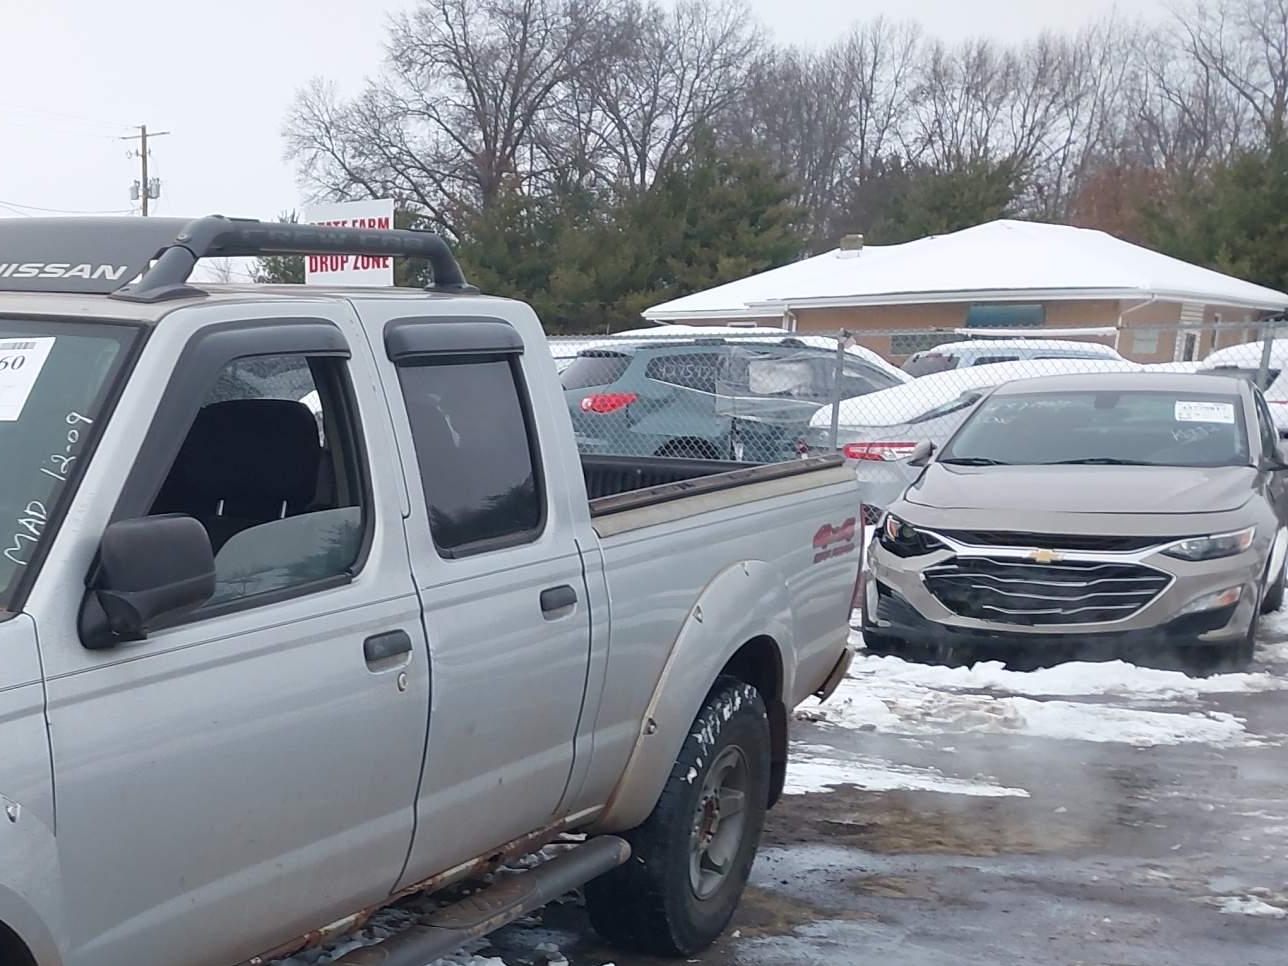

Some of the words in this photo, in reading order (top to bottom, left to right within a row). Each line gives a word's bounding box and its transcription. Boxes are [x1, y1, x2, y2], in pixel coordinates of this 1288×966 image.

[309, 255, 349, 273] DROP
[352, 256, 390, 270] ZONE
[3, 500, 47, 566] MAD
[39, 411, 94, 481] 12-09
